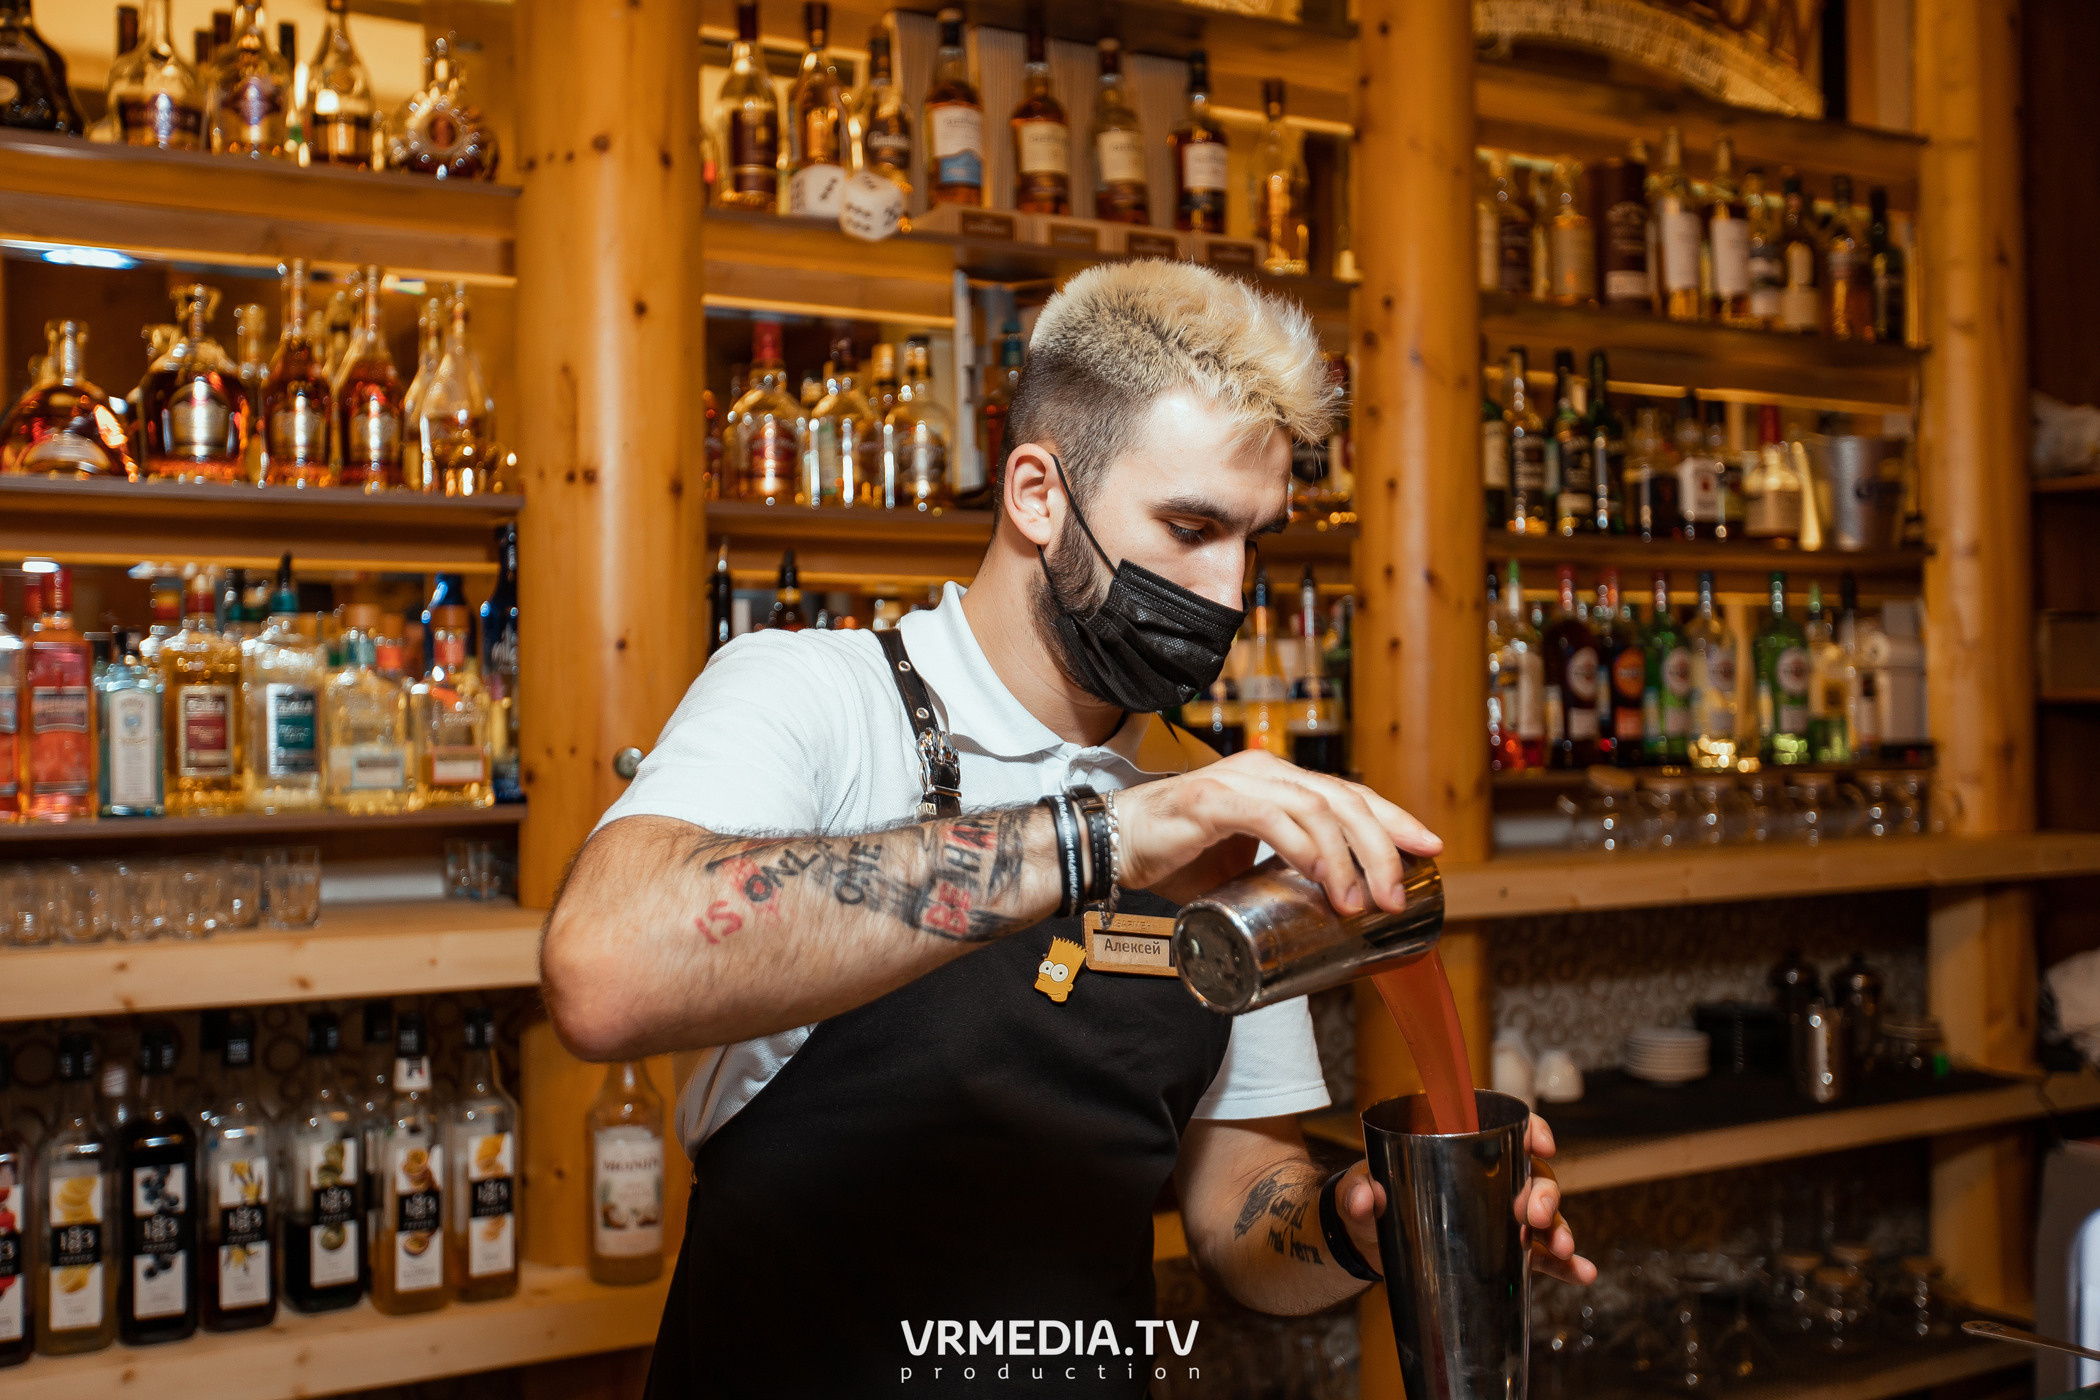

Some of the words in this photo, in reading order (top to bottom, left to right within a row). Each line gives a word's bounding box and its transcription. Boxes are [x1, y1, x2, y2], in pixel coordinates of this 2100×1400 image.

[834, 841, 883, 905] ONE
[694, 900, 744, 945] IS
[925, 881, 972, 935] BE
[1104, 938, 1162, 955] Алексей
